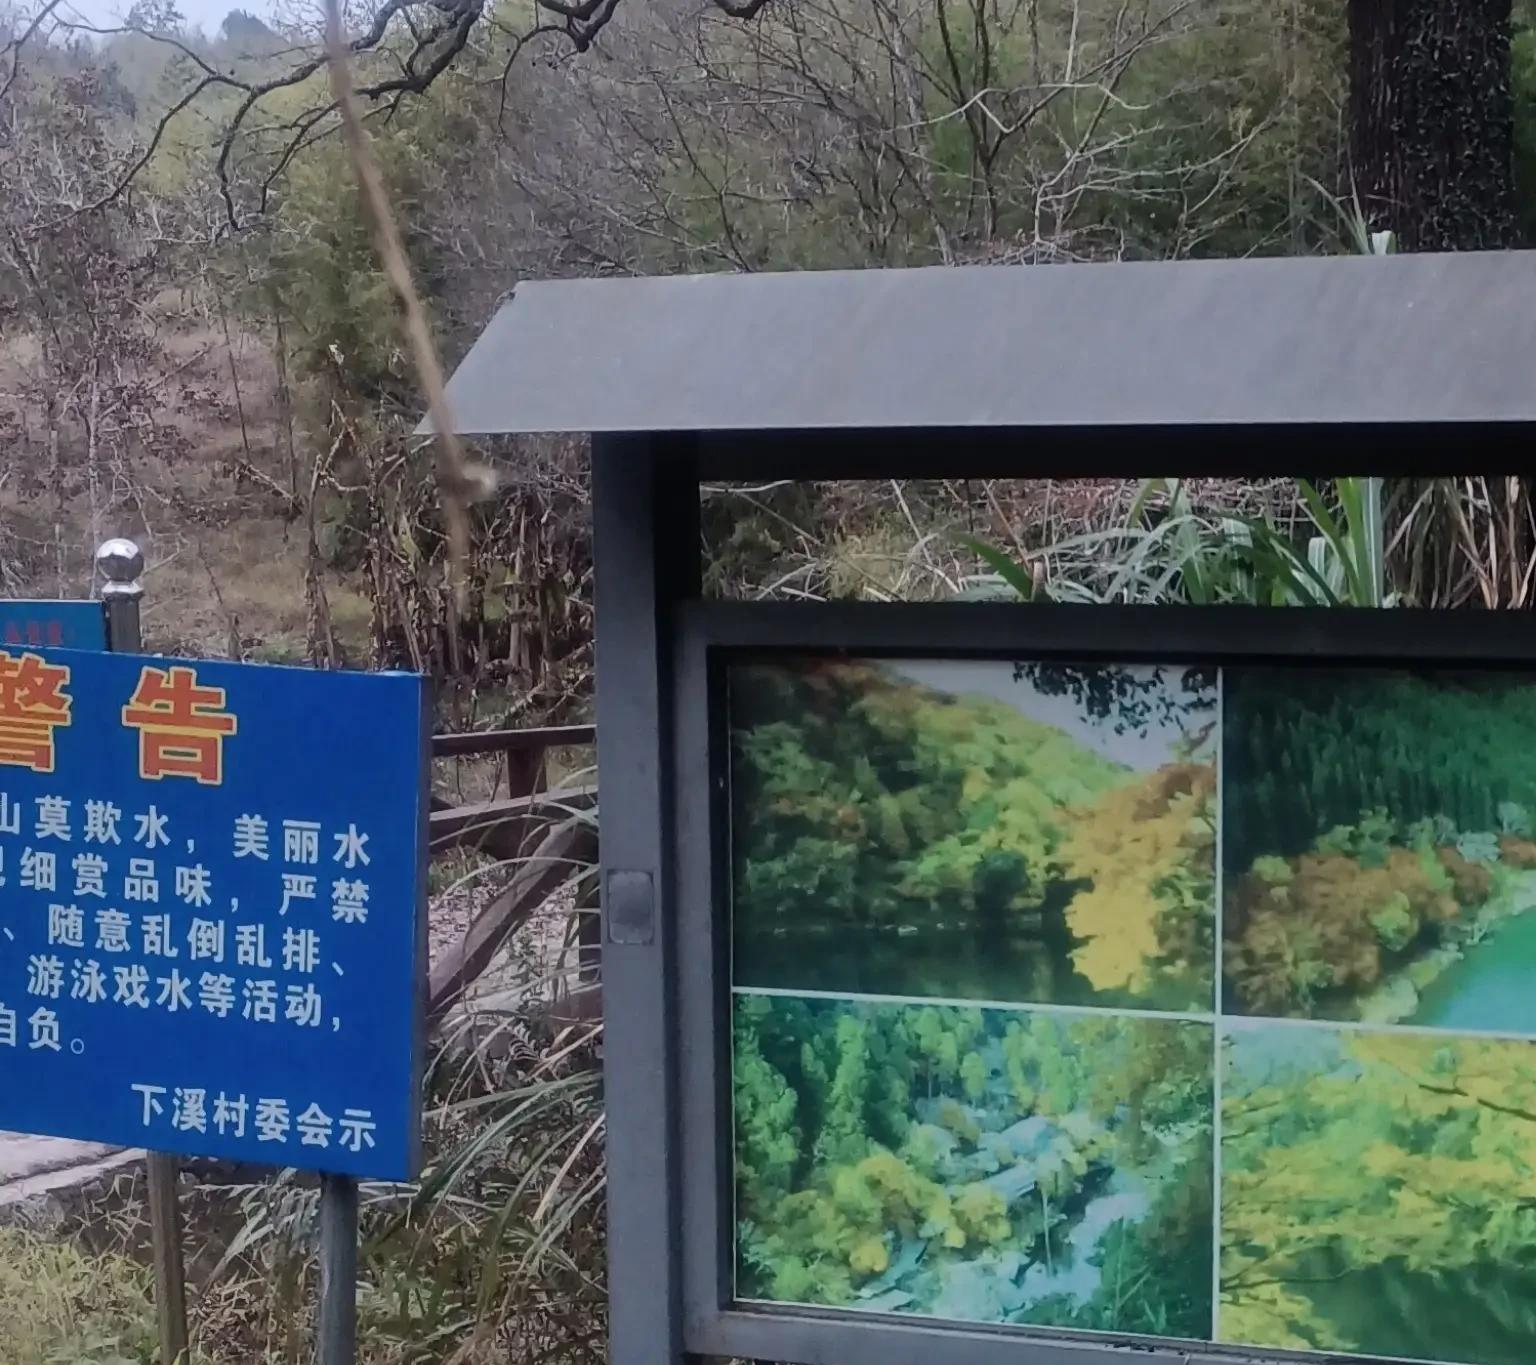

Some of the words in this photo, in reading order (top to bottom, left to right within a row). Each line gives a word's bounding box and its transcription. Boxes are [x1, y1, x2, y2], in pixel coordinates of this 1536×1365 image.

[0, 650, 237, 784] 警告
[0, 845, 370, 925] 细赏品味，严禁
[27, 954, 340, 1031] 游泳戏水等活动，
[130, 1083, 377, 1151] 下溪村委会示
